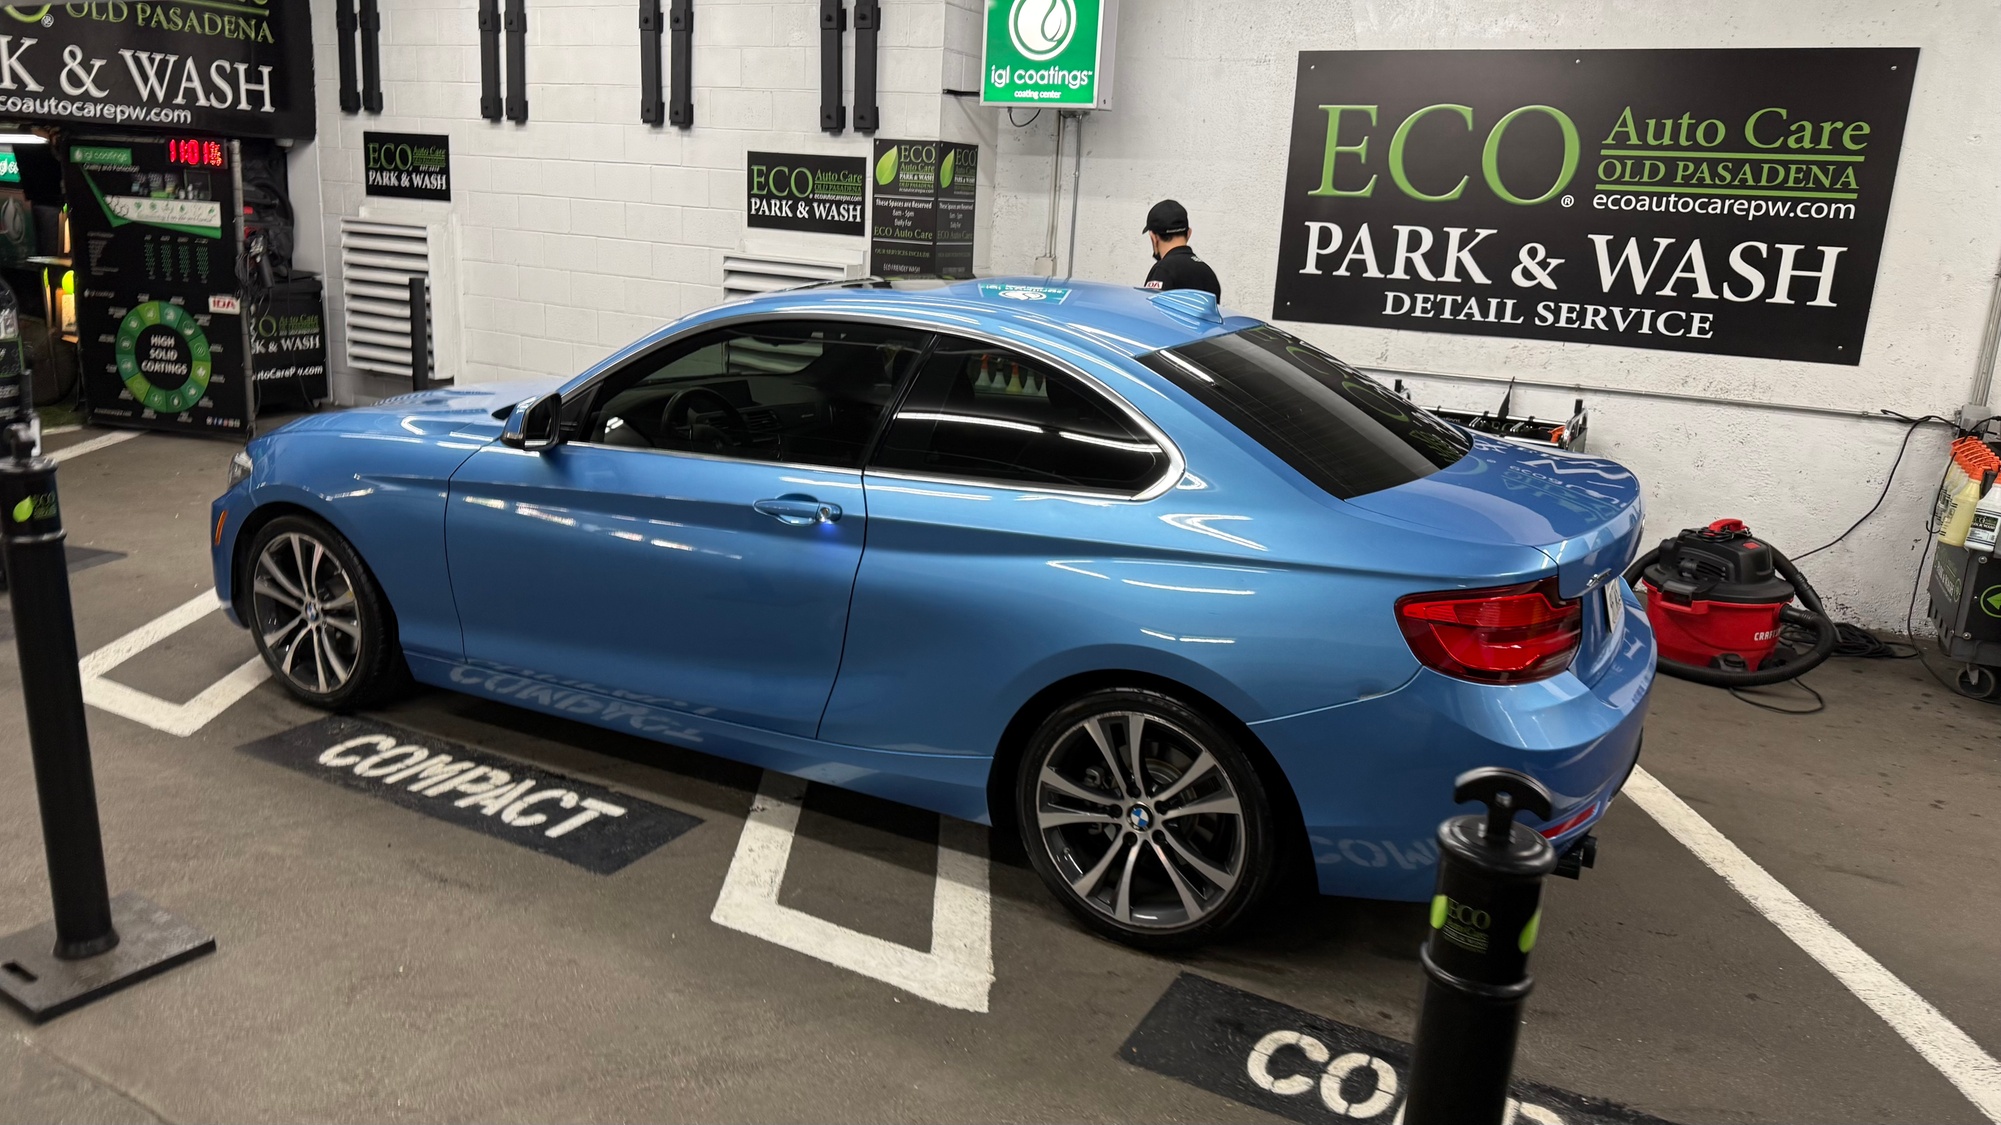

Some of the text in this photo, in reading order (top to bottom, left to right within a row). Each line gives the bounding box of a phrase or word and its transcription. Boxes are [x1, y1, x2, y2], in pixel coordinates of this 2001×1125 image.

[136, 3, 275, 44] PASADENA
[59, 44, 109, 98] &
[118, 48, 276, 113] WASH
[991, 64, 1010, 88] igl
[1014, 89, 1062, 100] coating center
[1602, 106, 1871, 150] Auto Care
[368, 142, 413, 171] ECO
[900, 145, 935, 164] ECO
[955, 148, 976, 167] ECO
[815, 169, 863, 184] Auto Care
[899, 172, 913, 180] PARK
[918, 173, 935, 182] WASH
[900, 163, 935, 173] Auto Care
[1597, 158, 1859, 189] OLD PASADENA
[368, 169, 446, 190] PARK & WASH
[751, 165, 814, 198] ECO
[814, 183, 862, 194] OLD PASADENA
[750, 197, 862, 222] PARK & WASH
[876, 199, 888, 207] These
[888, 200, 903, 208] Spaces
[911, 201, 932, 209] Reserved
[1592, 193, 1856, 221] ecoautocarepw.com
[874, 226, 933, 239] ECO Auto Care
[1299, 221, 1848, 307] PARK & WASH
[1382, 291, 1714, 339] DETAIL SERVICE
[150, 334, 175, 347] HIGH
[280, 334, 320, 351] WASH
[149, 348, 178, 361] SOLID
[141, 360, 188, 375] COATINGS
[318, 733, 627, 839] COMPACT
